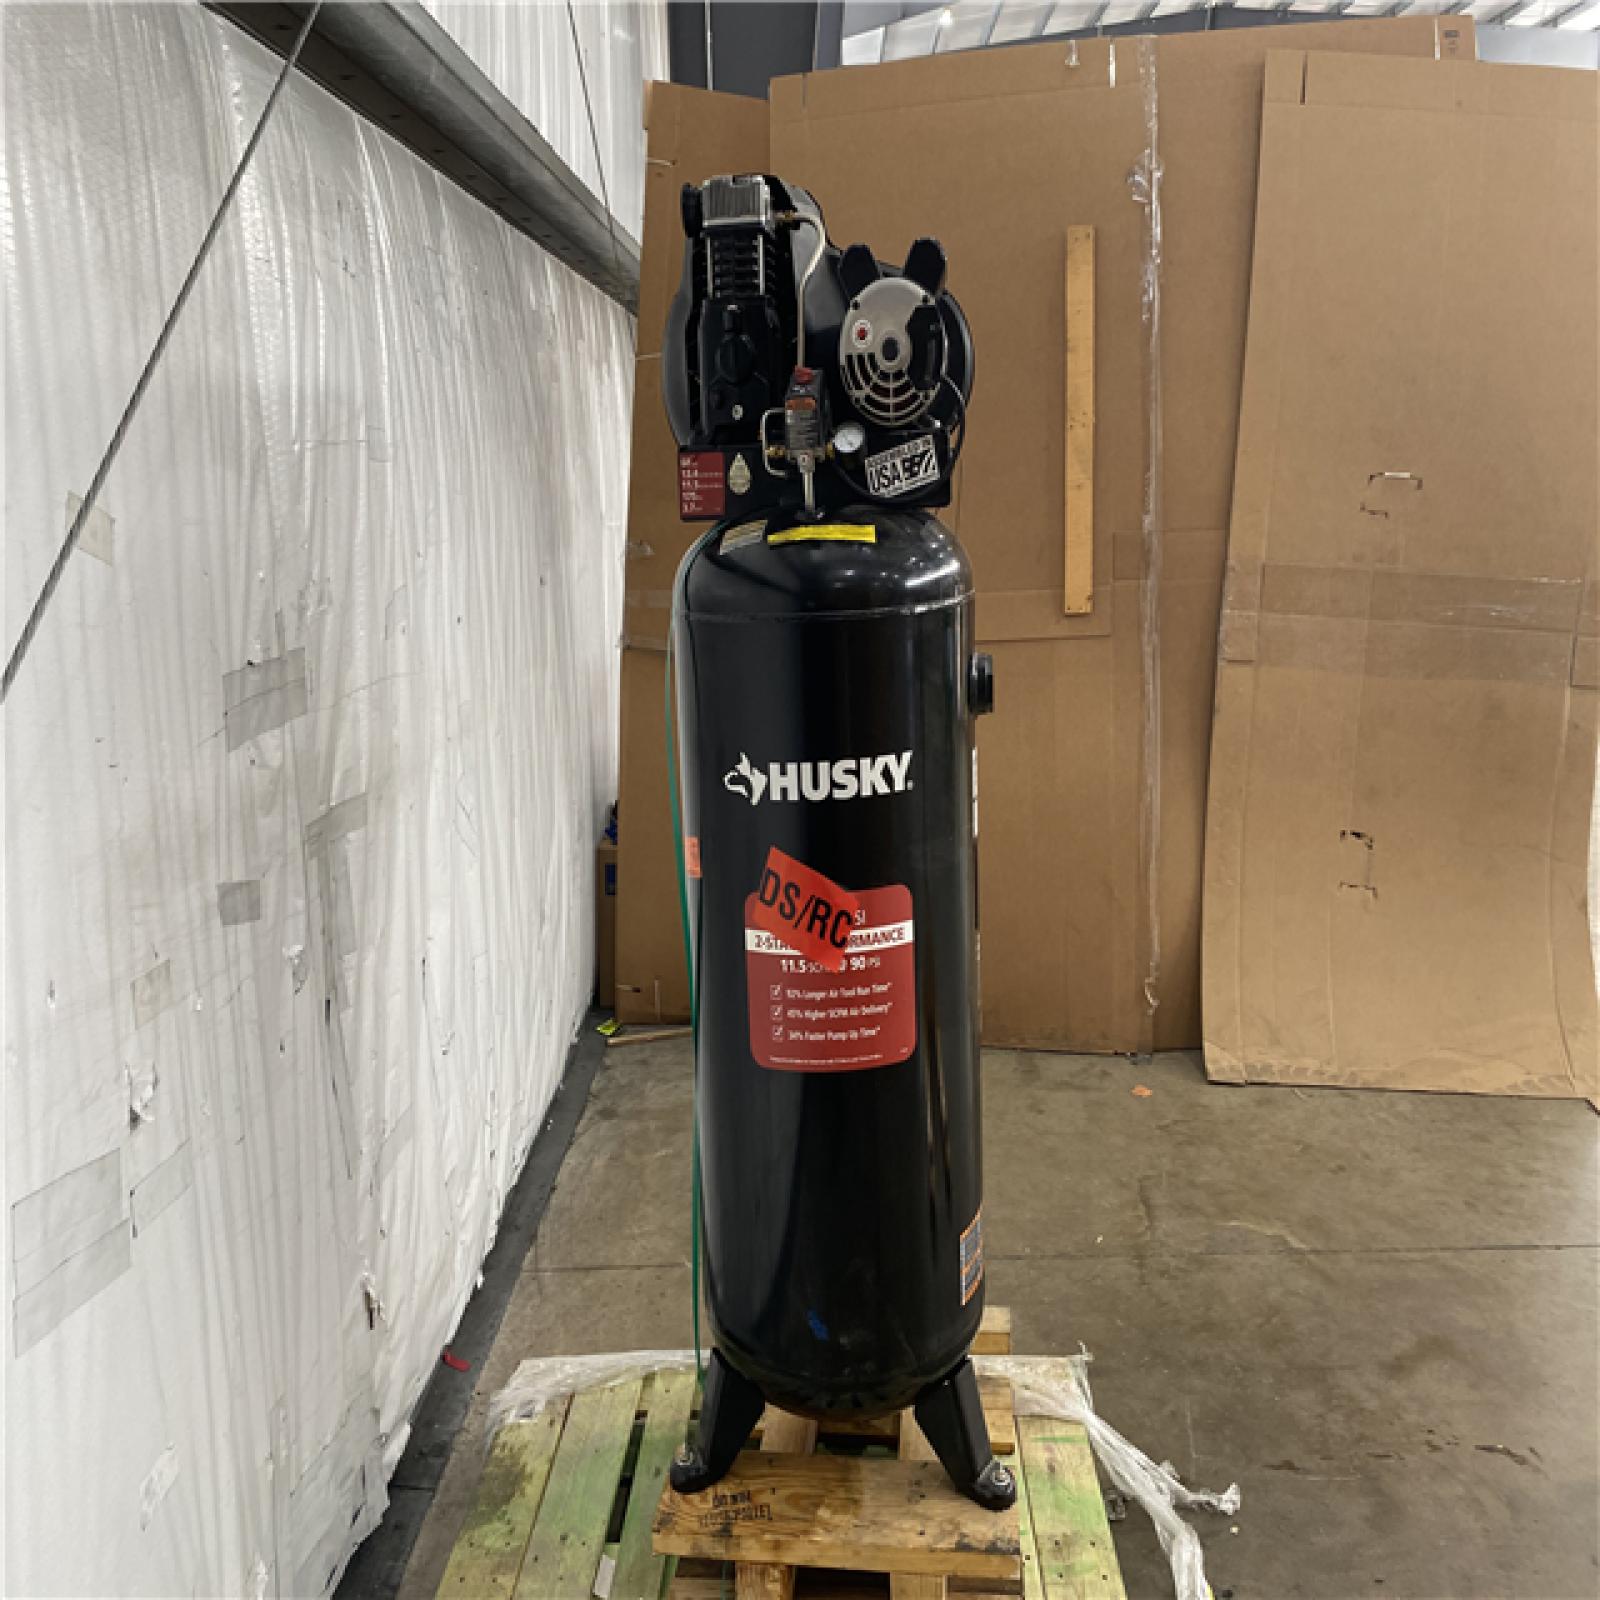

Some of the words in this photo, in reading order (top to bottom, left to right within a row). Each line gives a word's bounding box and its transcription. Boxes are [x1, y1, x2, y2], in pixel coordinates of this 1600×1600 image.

[768, 751, 913, 801] HUSKY
[759, 868, 853, 948] DS/RC
[854, 909, 865, 925] SI
[848, 927, 904, 947] RMANCE
[850, 955, 866, 970] 90
[804, 1009, 827, 1020] Higher
